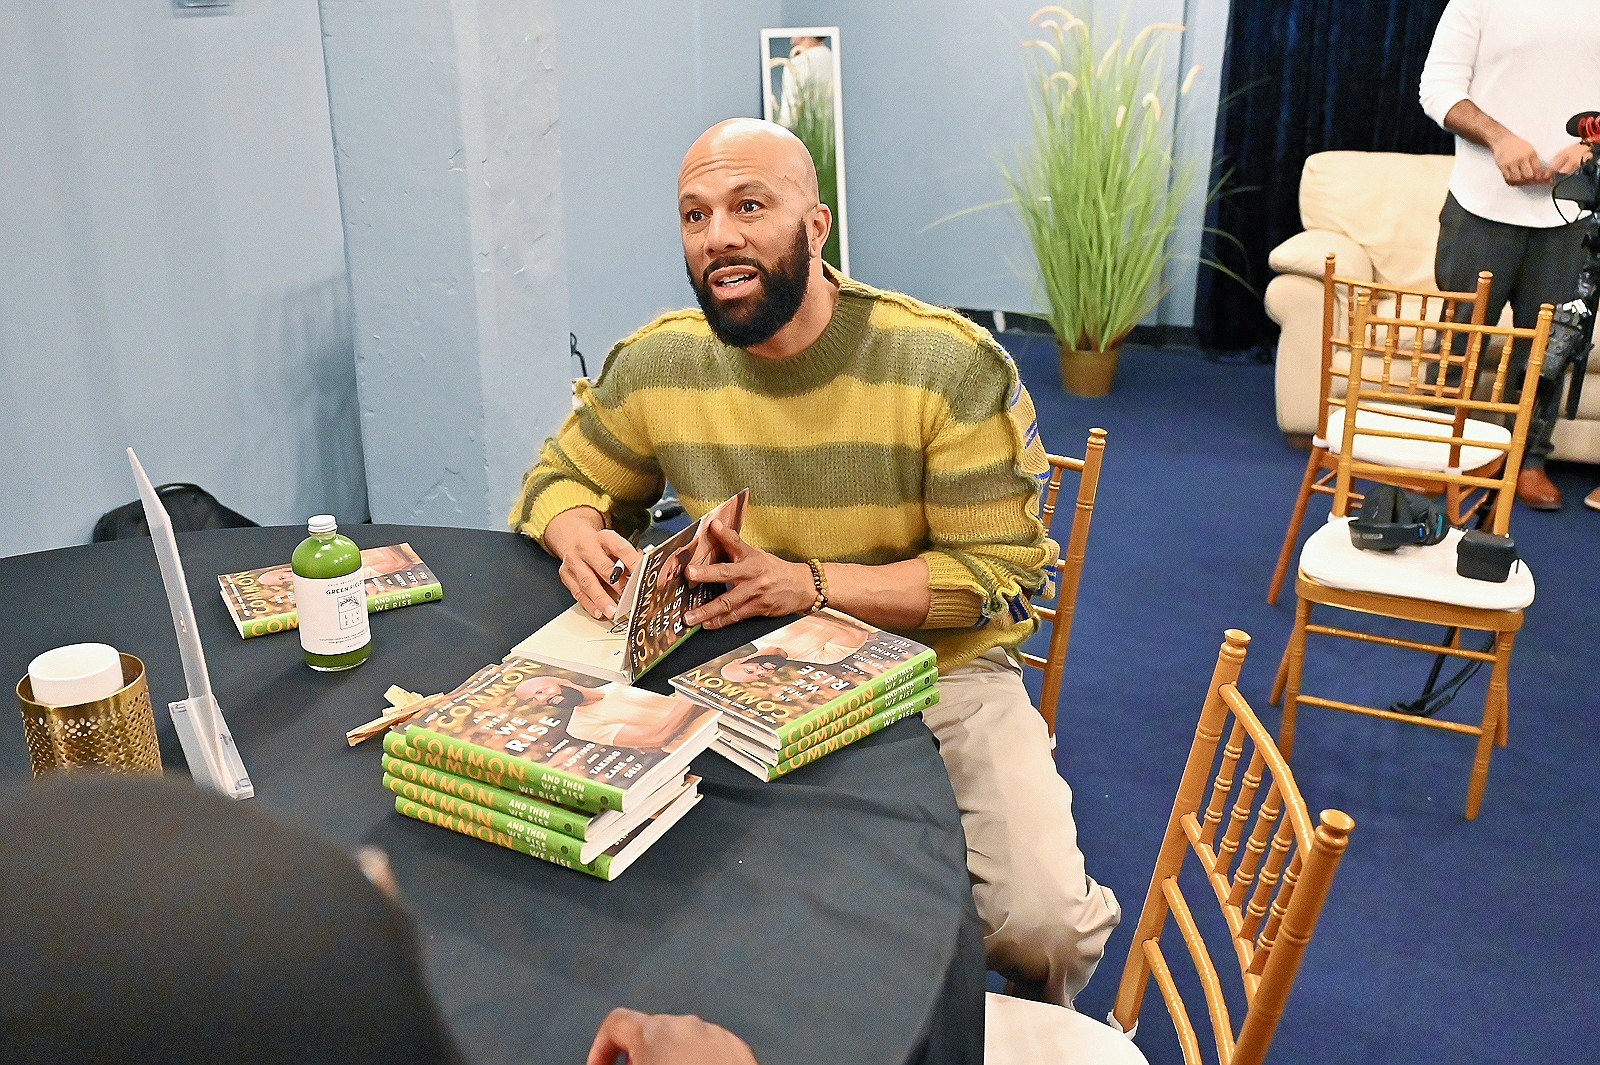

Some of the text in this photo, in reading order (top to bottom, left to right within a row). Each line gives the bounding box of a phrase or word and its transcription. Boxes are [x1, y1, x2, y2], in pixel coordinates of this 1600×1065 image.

[234, 571, 270, 614] COMMON
[326, 586, 349, 595] GREEN
[374, 592, 412, 605] AND THEN
[392, 599, 412, 608] RISE
[636, 550, 664, 662] COMMON
[672, 584, 685, 634] RISE
[663, 602, 672, 632] WE
[870, 645, 900, 660] TAKING
[888, 644, 908, 655] CARE
[892, 639, 912, 648] SELF
[852, 654, 884, 670] LOVING
[796, 664, 850, 691] RISE
[884, 665, 914, 685] AND THEN
[436, 661, 542, 729] COMMON
[686, 669, 790, 719] COMMON
[781, 686, 806, 700] THEN
[792, 678, 820, 694] WE
[884, 680, 914, 700] AND THEN
[885, 682, 896, 692] WE
[776, 693, 792, 702] AND
[885, 688, 914, 708] WE RISE
[473, 711, 492, 724] AND
[788, 686, 874, 744] COMMON
[882, 700, 914, 720] AND THEN
[882, 708, 914, 728] WE RISE
[480, 712, 510, 730] THEN
[495, 717, 528, 736] WE
[784, 702, 874, 759] COMMON
[504, 716, 562, 752] RISE
[564, 742, 596, 767] LOVING
[776, 720, 871, 774] COMMON
[412, 735, 526, 780] COMMON
[589, 750, 622, 775] TAKING
[604, 761, 627, 779] CARE
[623, 762, 643, 778] SELF
[388, 758, 495, 808] COMMON
[541, 773, 585, 792] AND THEN
[390, 778, 494, 828] COMMON
[508, 799, 551, 818] AND THEN
[402, 802, 513, 848] COMMON
[506, 820, 548, 840] AND THEN
[550, 855, 572, 868] RISE
